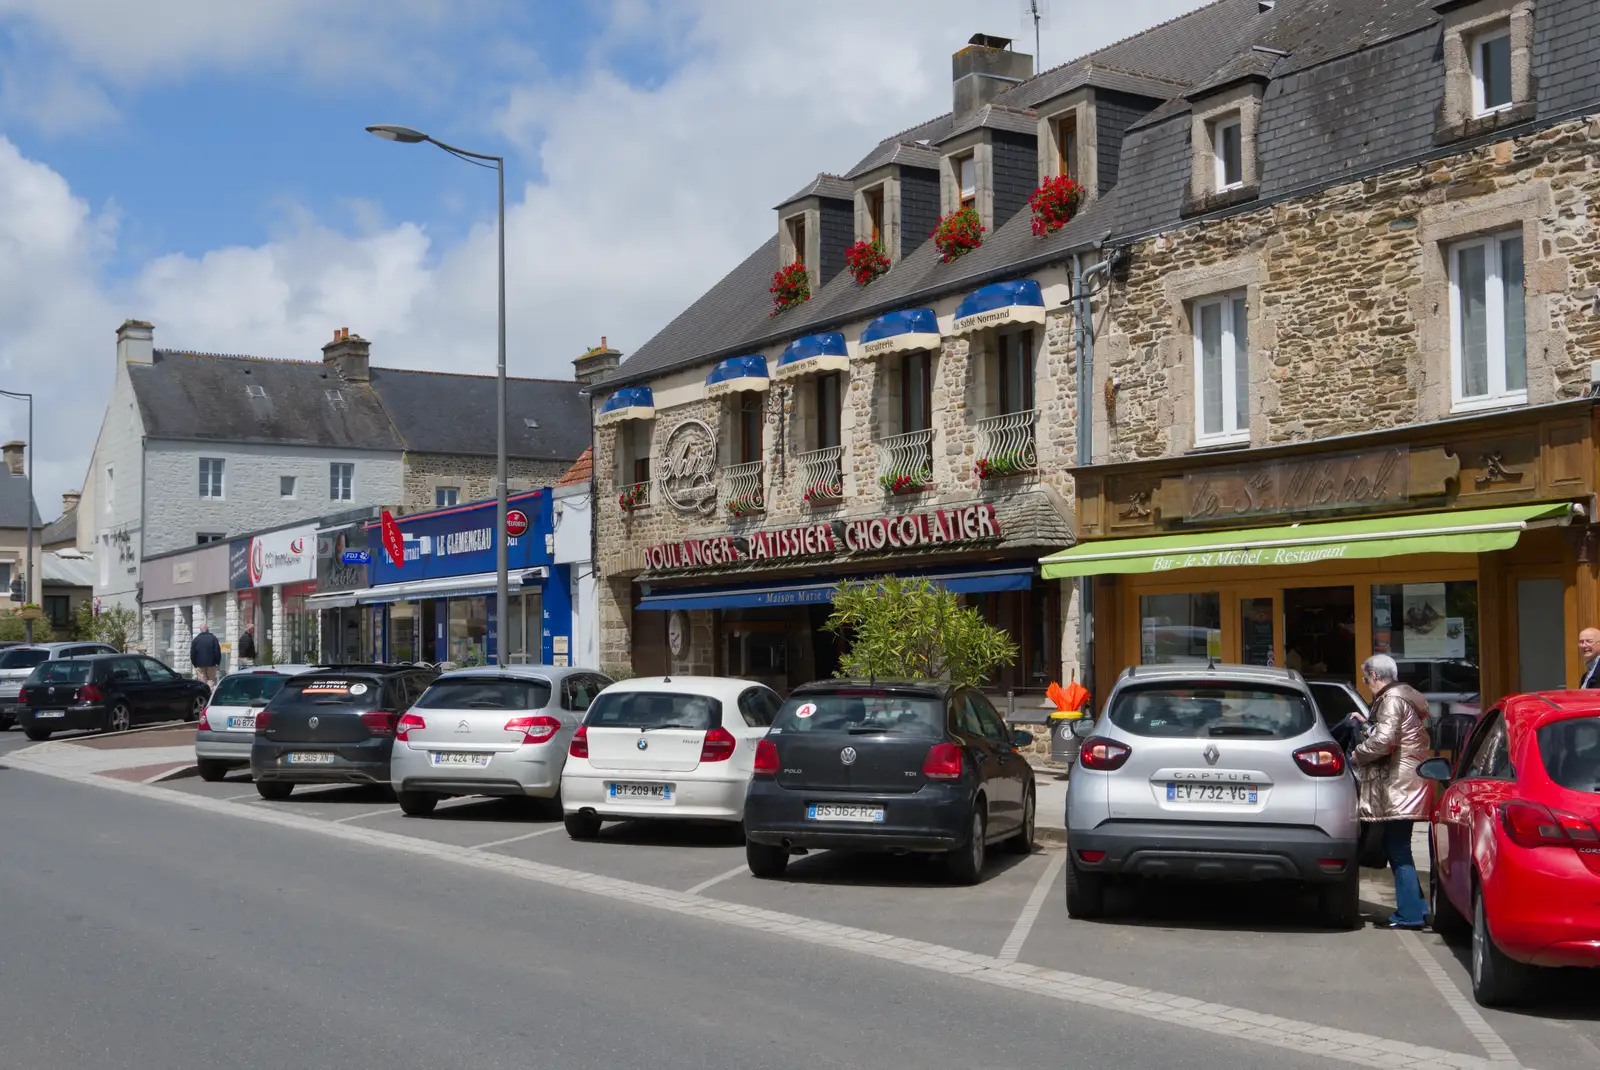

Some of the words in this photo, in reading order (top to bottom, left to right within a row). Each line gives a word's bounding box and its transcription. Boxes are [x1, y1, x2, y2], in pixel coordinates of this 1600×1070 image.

[960, 315, 976, 328] Sablé
[977, 309, 1010, 325] Normand
[864, 339, 894, 353] Biscuiterie
[1280, 450, 1399, 511] Michel
[386, 522, 400, 556] TABAC
[436, 536, 446, 556] LE
[447, 528, 492, 555] CLEMENCEAU
[643, 537, 736, 569] BOULANGER
[750, 524, 832, 560] PATISSIER
[845, 505, 996, 551] CHOCOLATIER
[1153, 557, 1173, 571] Bar
[1184, 555, 1195, 567] le
[1198, 553, 1212, 566] St
[1215, 550, 1262, 565] Michel
[1274, 546, 1346, 563] Restaurant
[766, 592, 795, 603] Maison
[798, 590, 822, 601] Marie
[800, 706, 811, 715] A
[1174, 772, 1252, 781] CAPTUR
[616, 784, 664, 797] BT-209-MZ
[1176, 784, 1246, 801] EV-732-VG
[816, 805, 875, 818] BS-062-RZ
